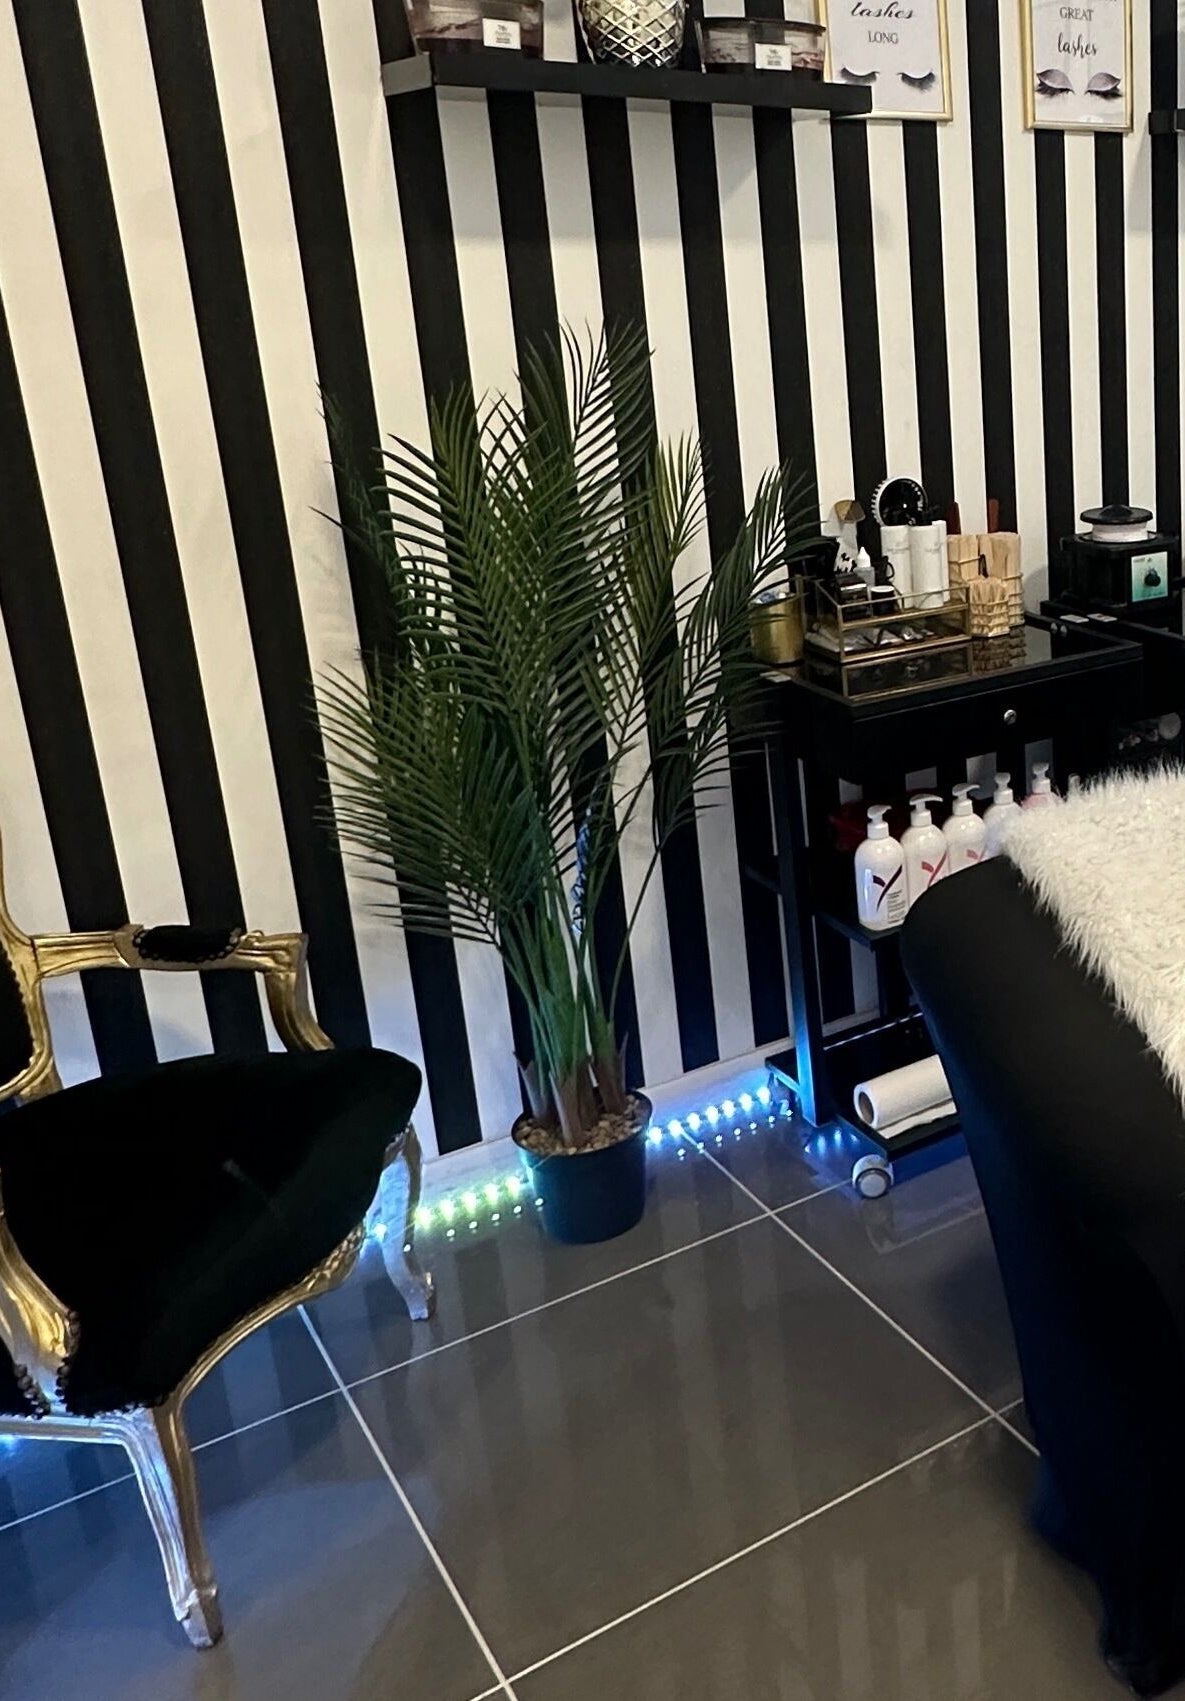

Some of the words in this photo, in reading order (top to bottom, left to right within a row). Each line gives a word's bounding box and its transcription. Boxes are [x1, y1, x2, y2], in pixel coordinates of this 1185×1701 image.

[850, 1, 914, 19] lashes
[1059, 6, 1094, 21] GREAT
[868, 30, 899, 44] LONG
[1057, 32, 1097, 59] lashes
